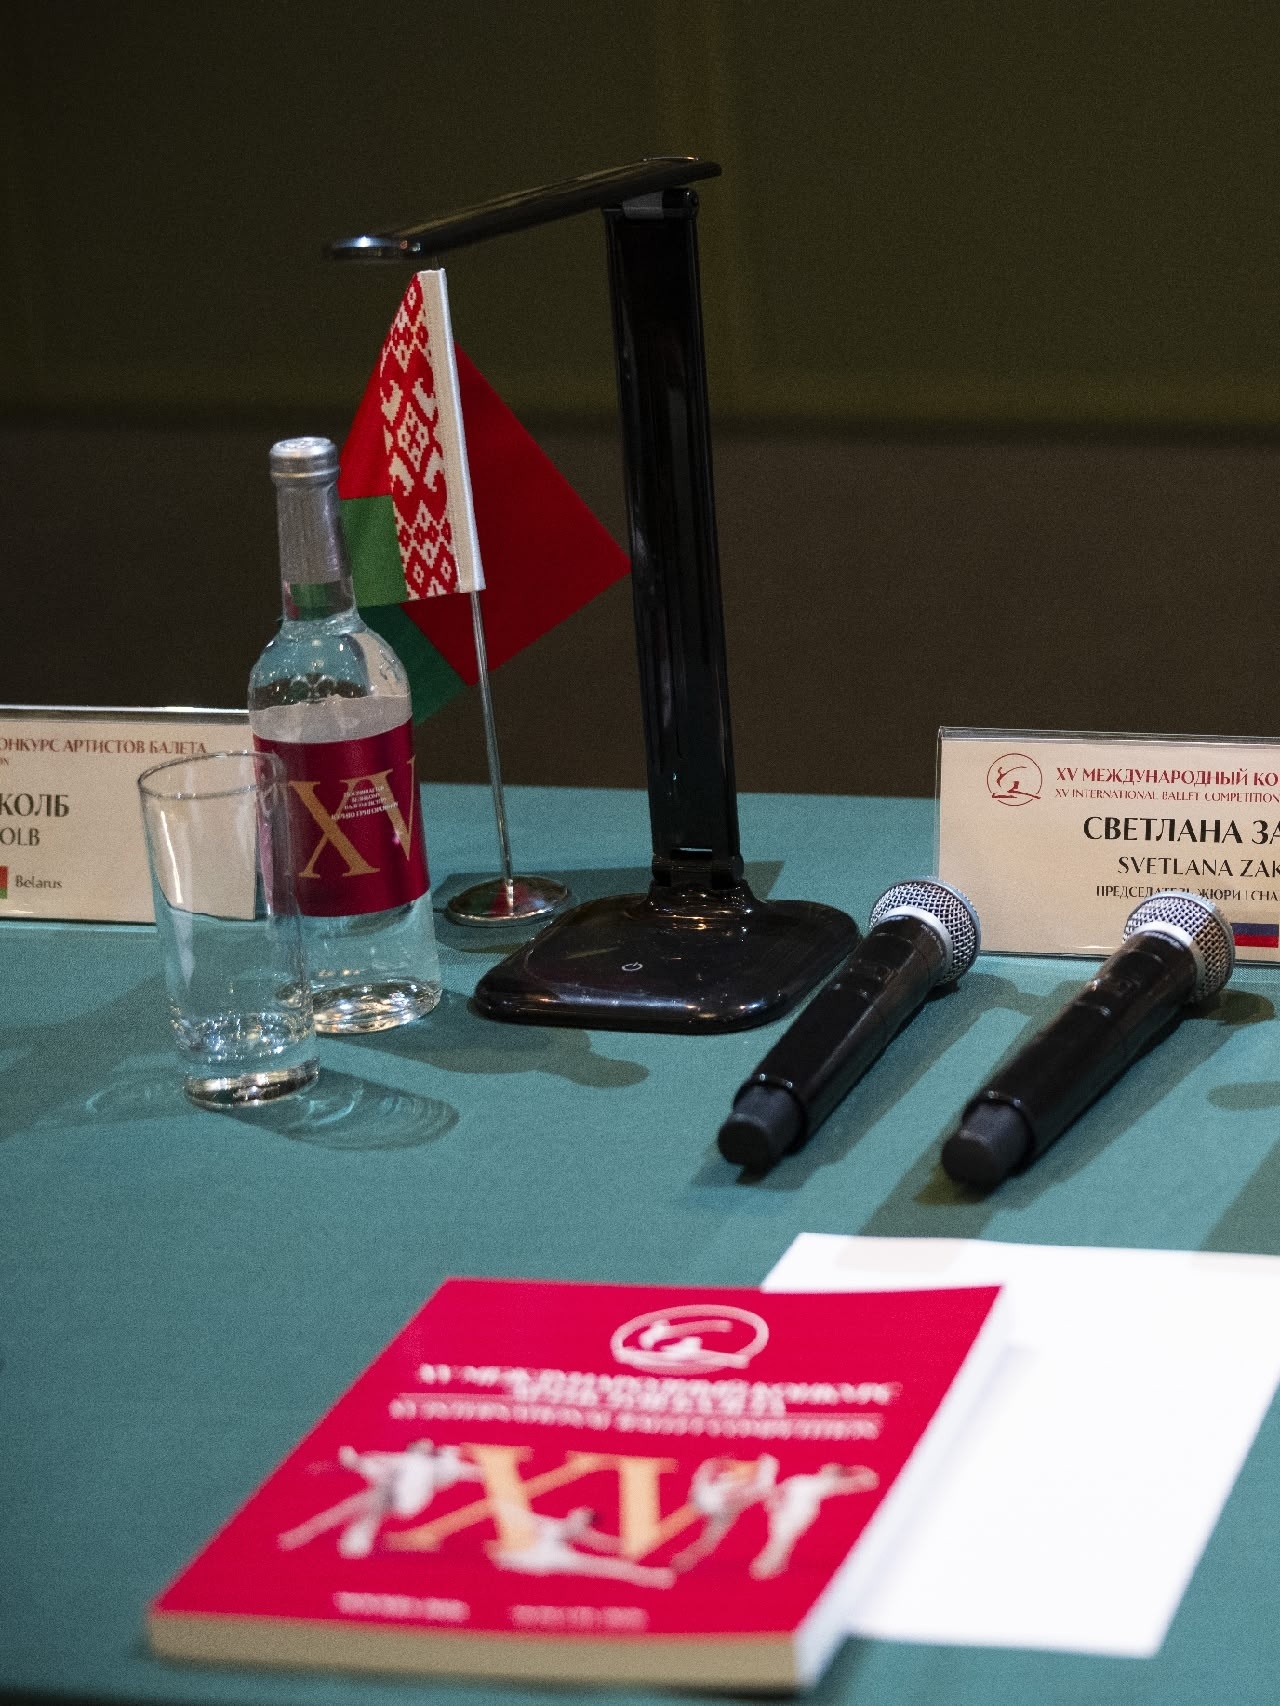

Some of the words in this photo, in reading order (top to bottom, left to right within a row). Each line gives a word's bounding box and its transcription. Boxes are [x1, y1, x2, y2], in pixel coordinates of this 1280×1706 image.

[64, 738, 145, 754] АРТИСТОВ
[150, 741, 207, 755] БАЛЕТА
[1056, 767, 1078, 781] XV
[1082, 768, 1248, 787] МЕЖДУНАРОДНЫЙ
[0, 793, 70, 818] КОЛБ
[1054, 788, 1070, 798] XV
[1072, 789, 1158, 800] INTERNATIONAL
[1162, 791, 1200, 801] BALLET
[1204, 792, 1280, 803] COMPETITION
[1083, 816, 1243, 844] СВЕТЛАНА
[1117, 856, 1234, 876] SVETLANA
[15, 874, 63, 889] Belarus
